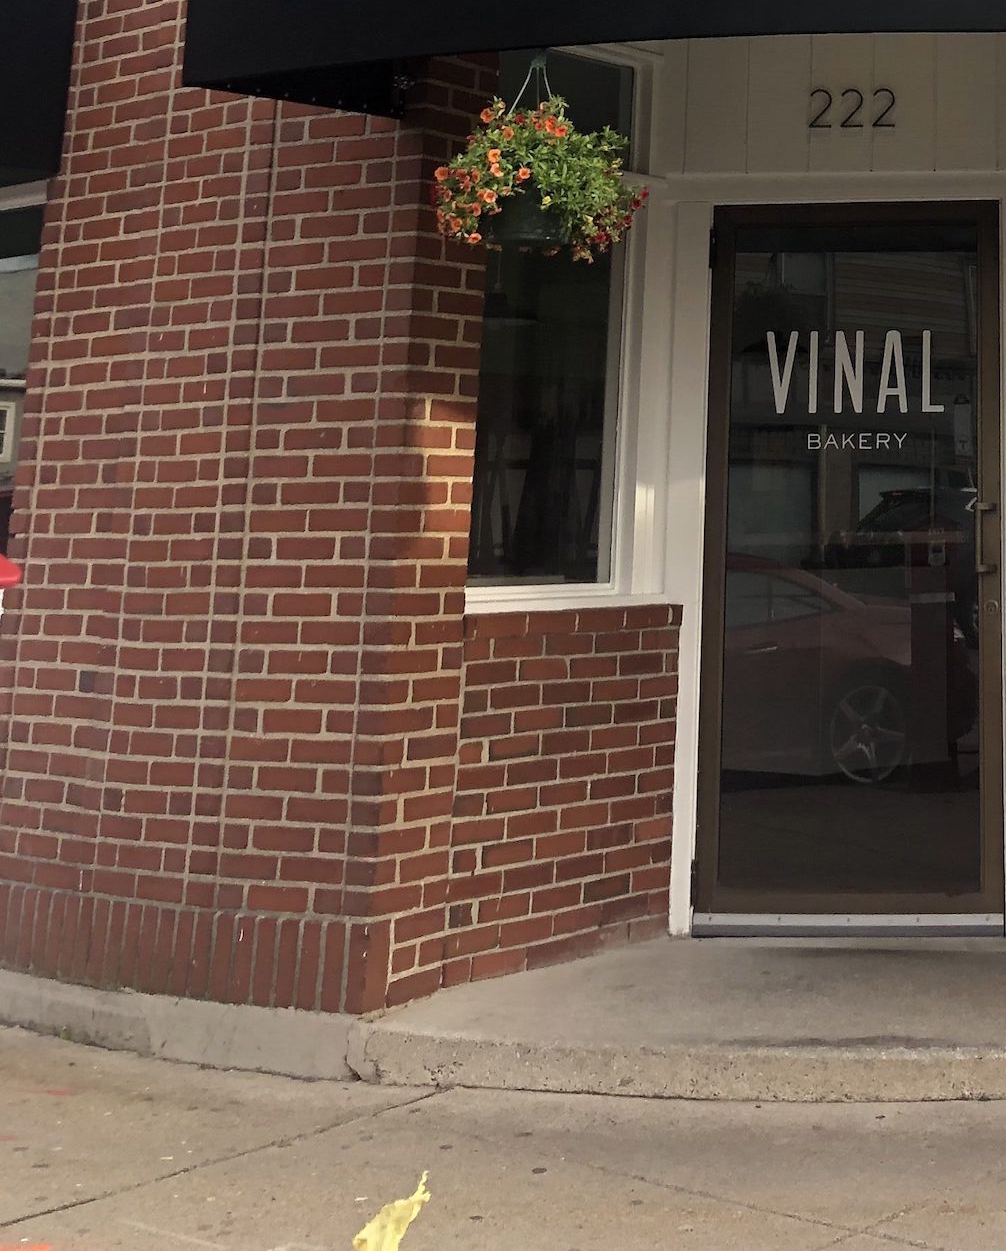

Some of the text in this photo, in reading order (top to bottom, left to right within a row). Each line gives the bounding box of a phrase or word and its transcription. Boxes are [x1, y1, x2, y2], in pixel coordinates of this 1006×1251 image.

[808, 87, 896, 129] 222
[766, 329, 945, 414] VINAL
[807, 432, 908, 450] BAKERY
